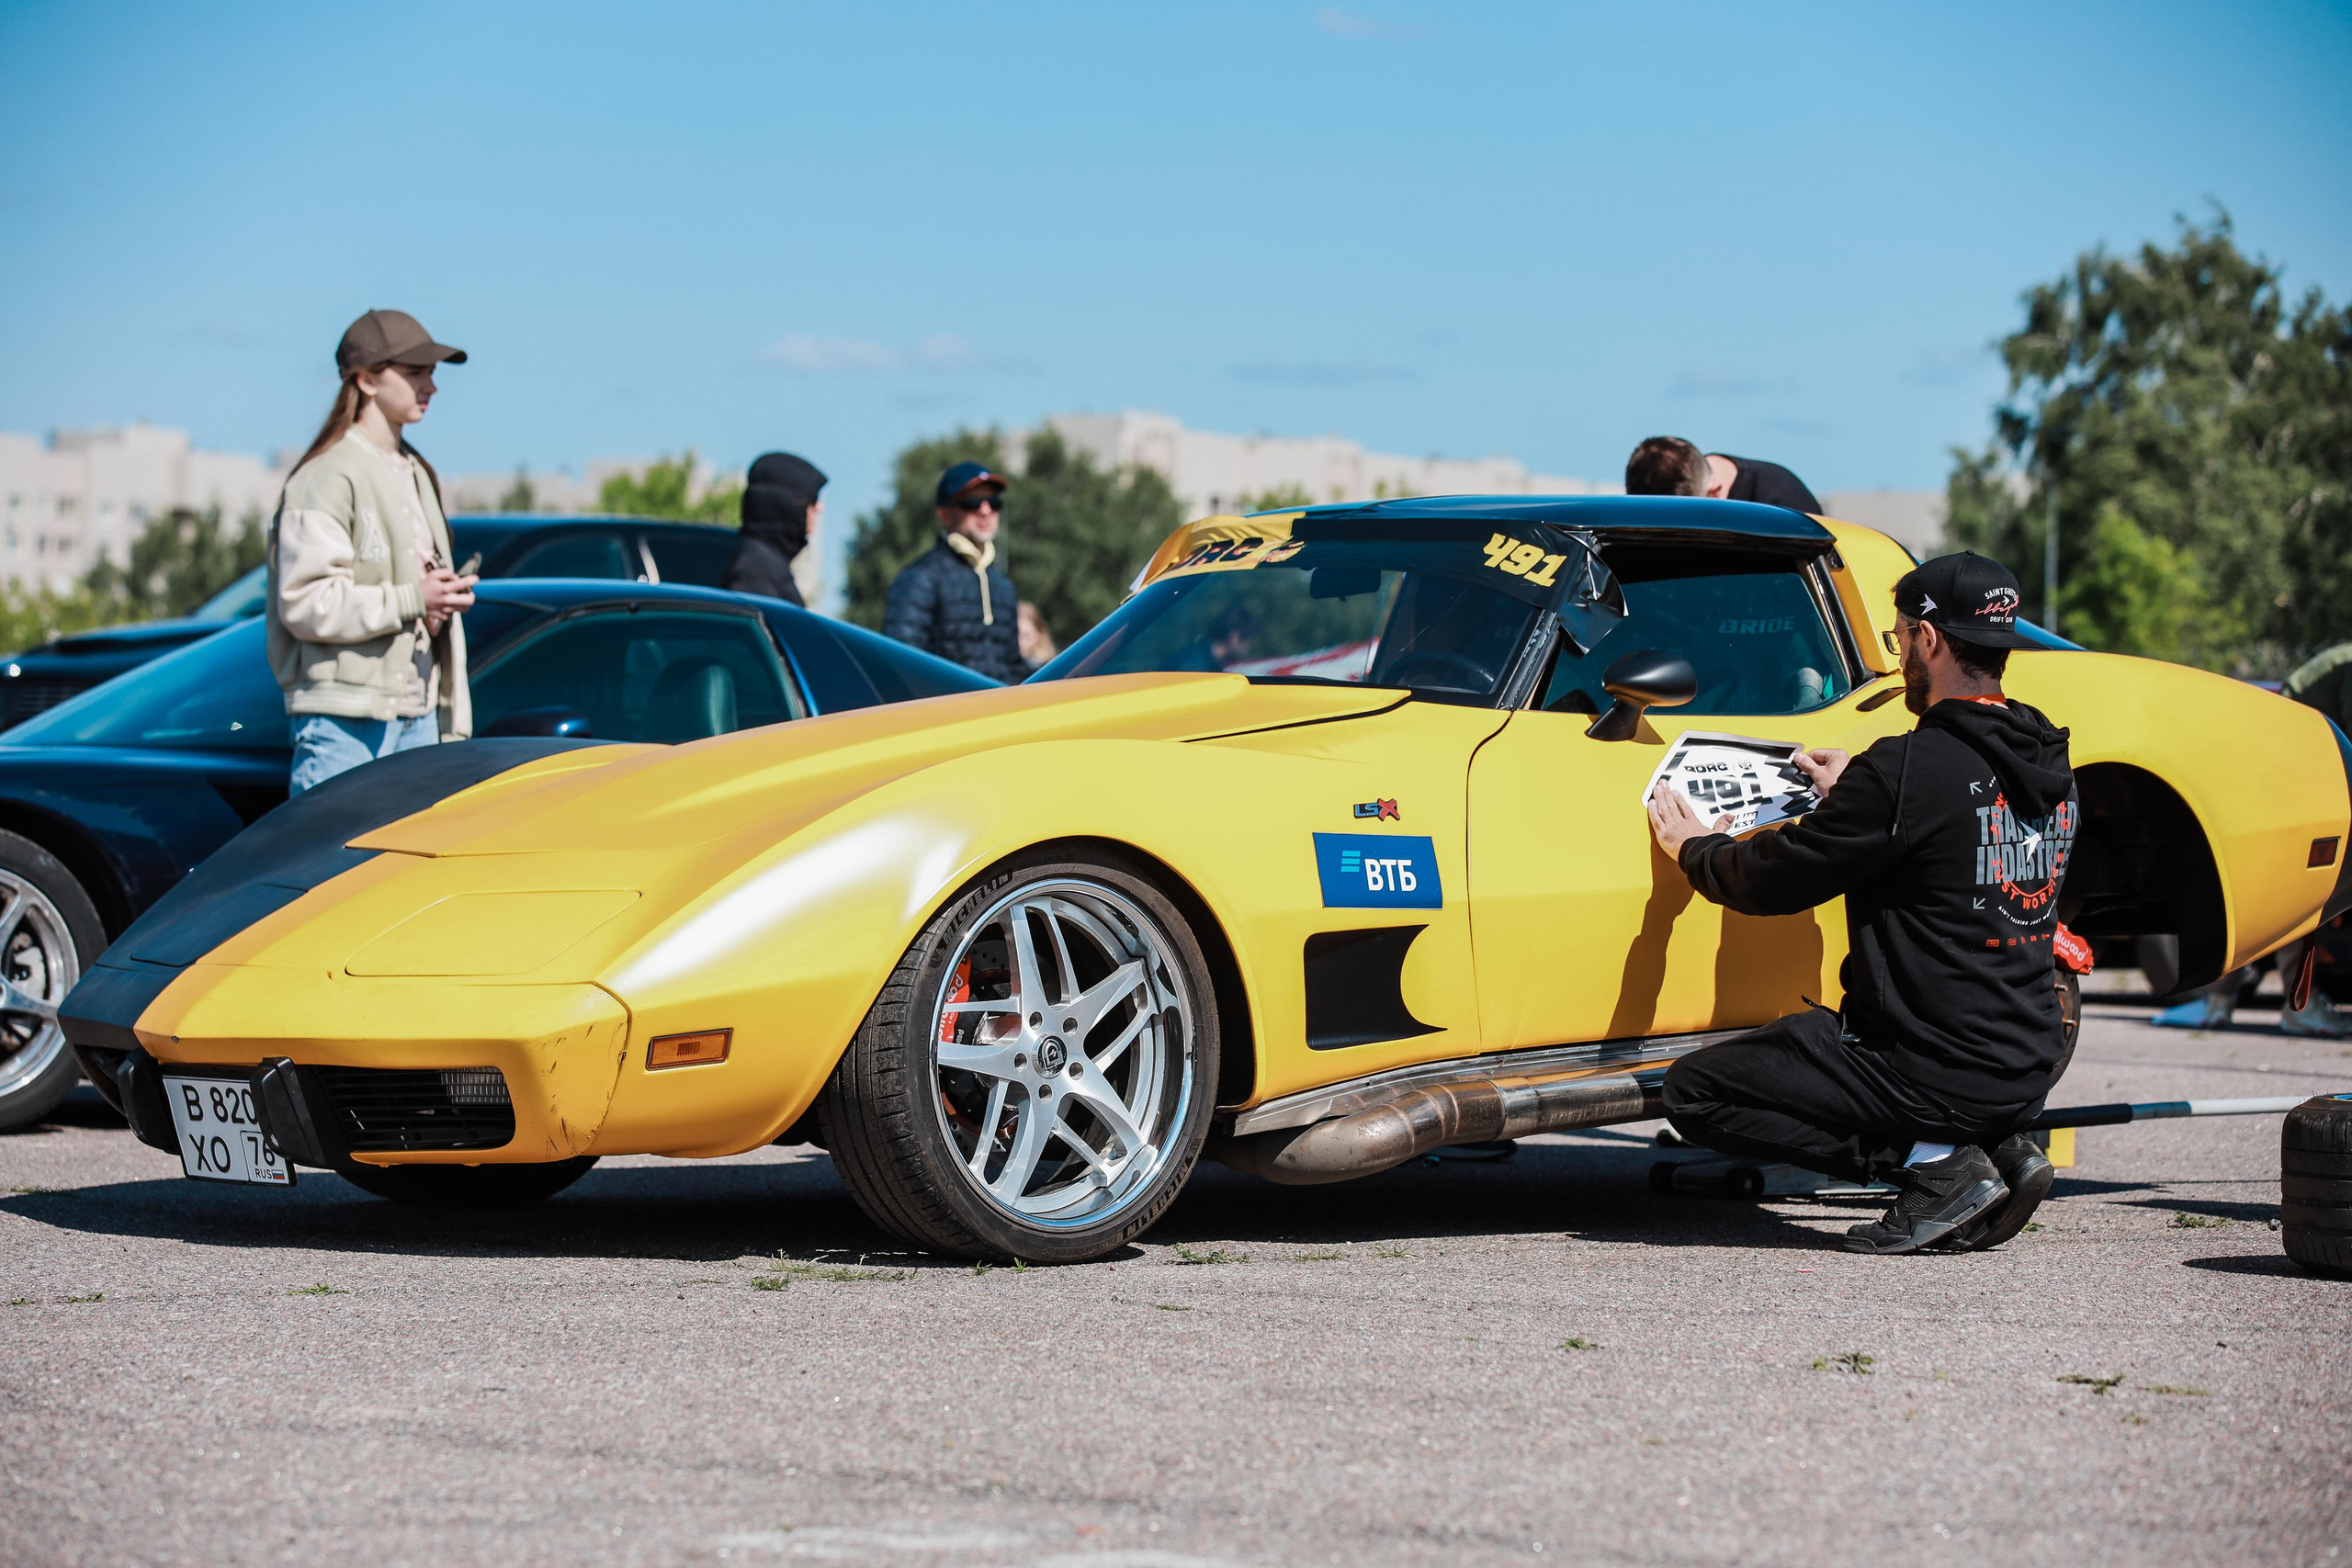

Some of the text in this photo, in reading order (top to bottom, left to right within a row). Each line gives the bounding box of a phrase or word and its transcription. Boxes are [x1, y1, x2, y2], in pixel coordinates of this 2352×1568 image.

[1483, 533, 1567, 588] 491
[1984, 587, 2004, 600] SAINT
[1718, 615, 1796, 634] BRIDE
[1354, 798, 1400, 822] LSX
[1364, 858, 1417, 892] ВТБ
[943, 873, 1010, 944] MICHELIN
[2053, 931, 2086, 962] ilwood
[209, 1087, 258, 1125] 820
[255, 1168, 273, 1179] RUS
[1126, 1159, 1189, 1236] MICHELIN
